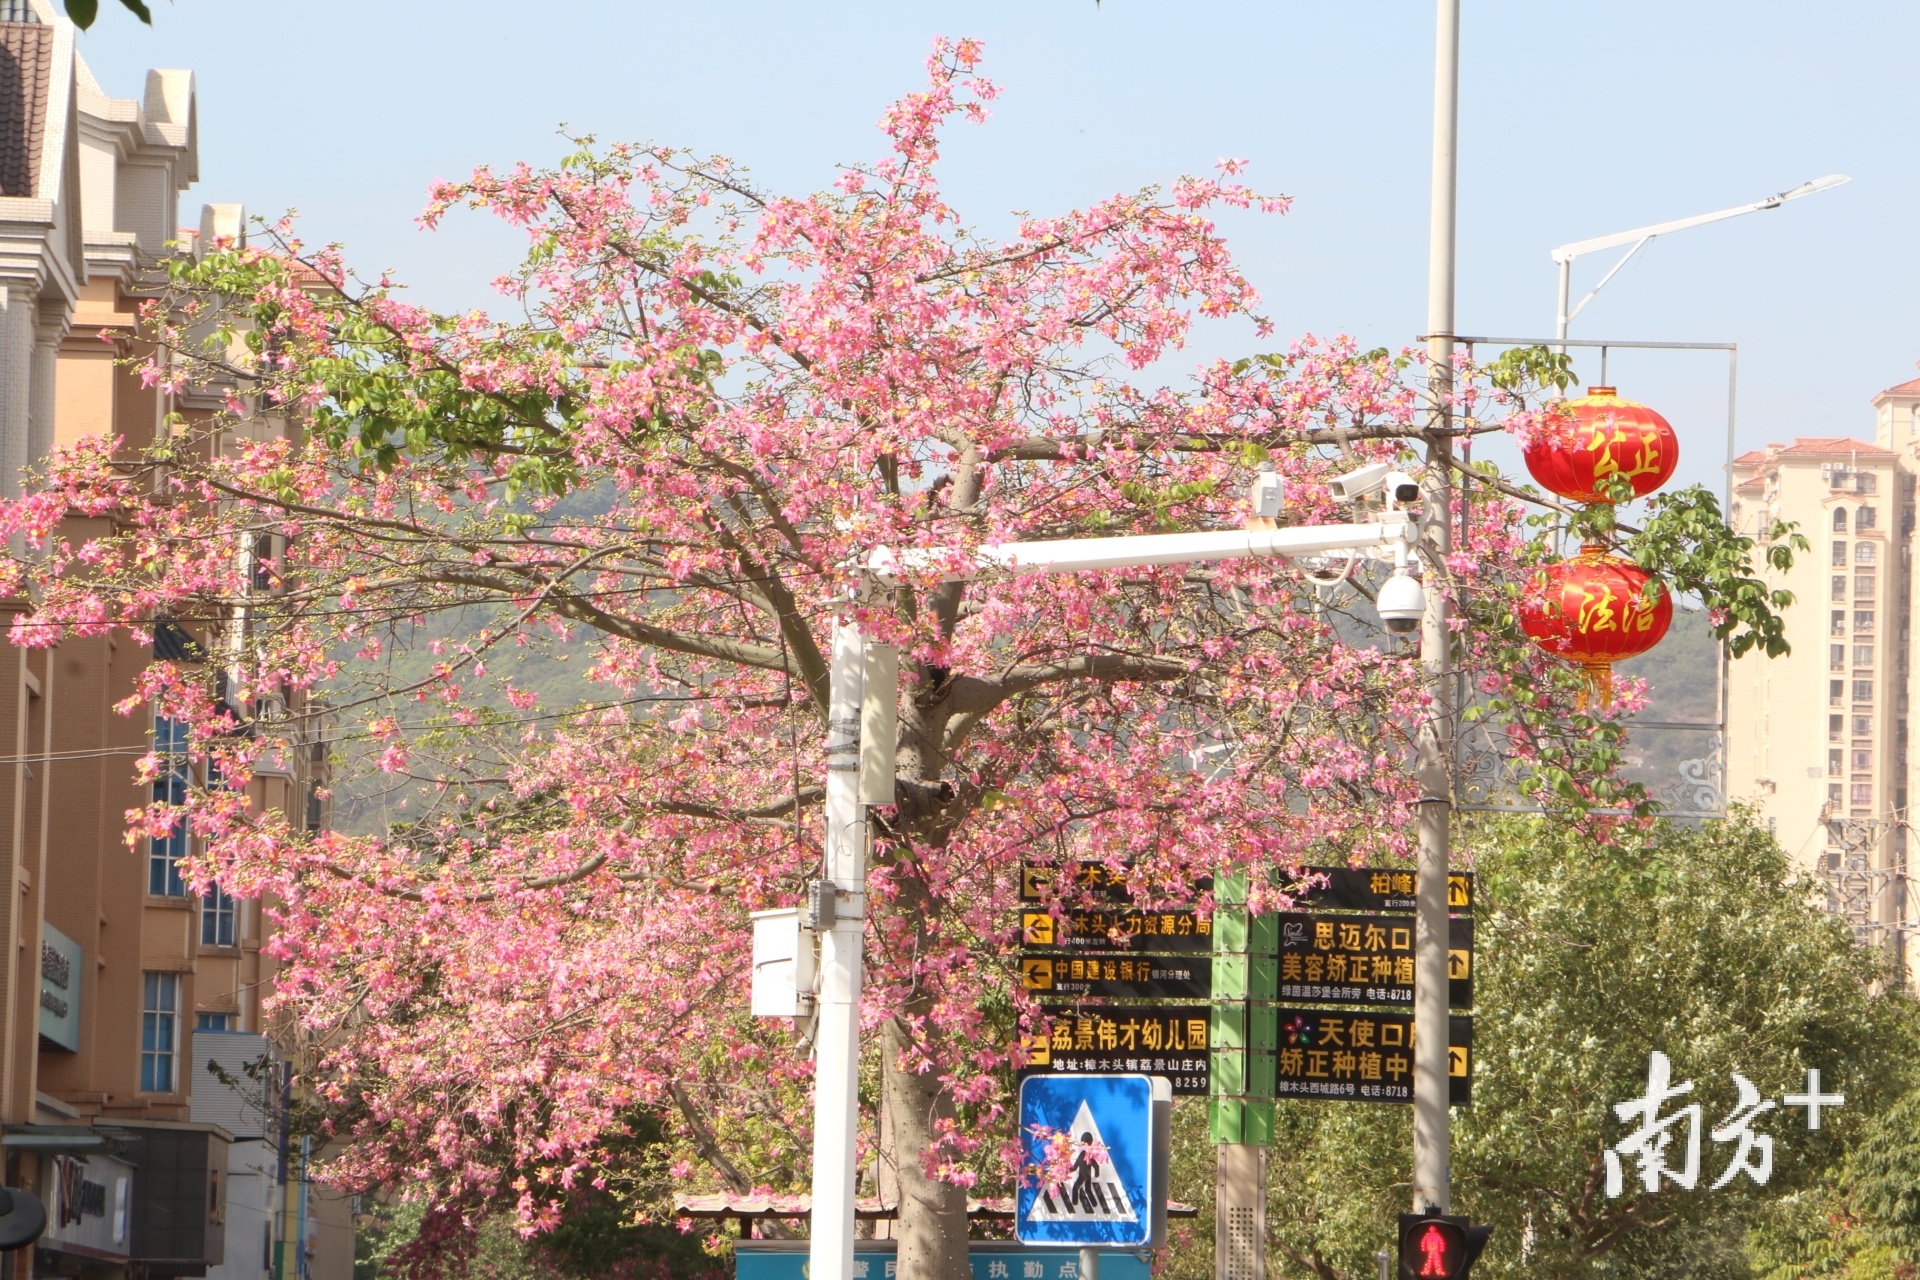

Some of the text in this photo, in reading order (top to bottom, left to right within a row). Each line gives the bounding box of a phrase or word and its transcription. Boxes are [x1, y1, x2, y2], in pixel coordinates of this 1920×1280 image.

[1587, 430, 1660, 478] 公正
[1578, 584, 1655, 635] 法治
[1370, 873, 1417, 895] 柏峰
[1058, 914, 1211, 936] 木头人力资源分局
[1055, 960, 1192, 981] 中国建设银行 银河分理处
[1282, 952, 1415, 985] 美容矫正种植
[1051, 1018, 1207, 1051] 荔景伟才幼儿园
[1280, 1047, 1415, 1082] 矫正种植中
[1175, 1077, 1207, 1088] 8259
[1279, 1081, 1356, 1096] 樟木头西城路6号
